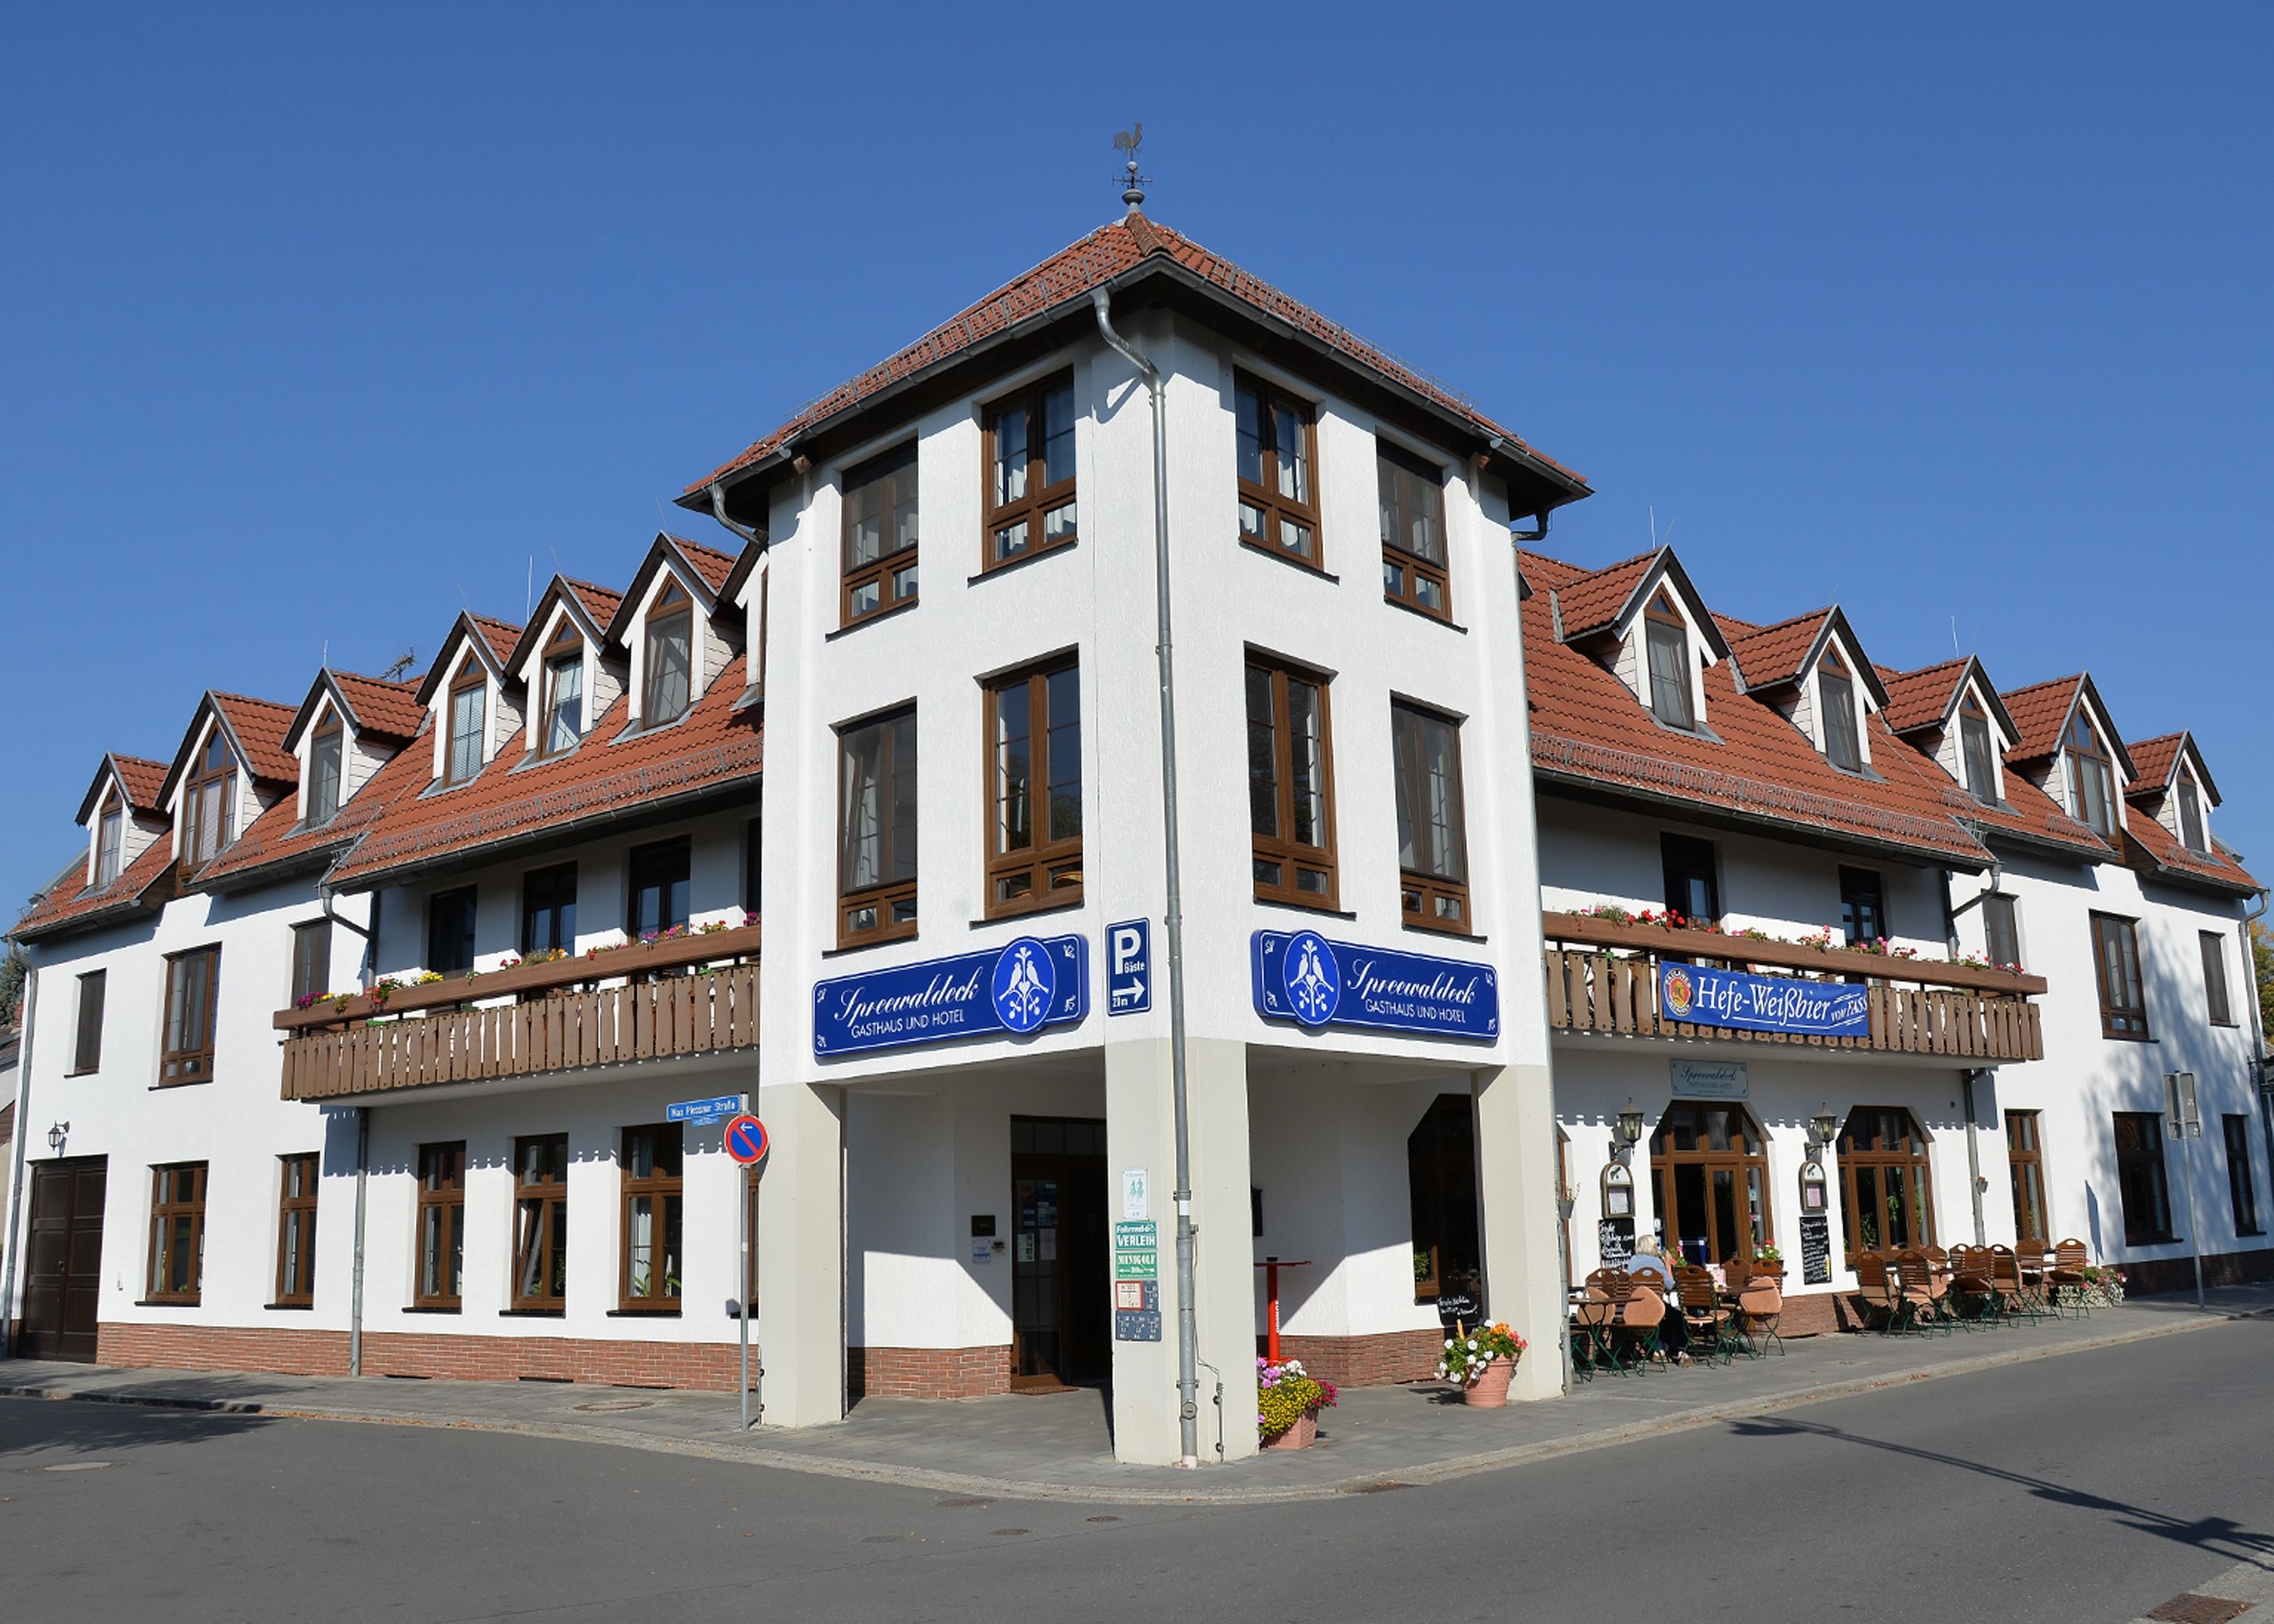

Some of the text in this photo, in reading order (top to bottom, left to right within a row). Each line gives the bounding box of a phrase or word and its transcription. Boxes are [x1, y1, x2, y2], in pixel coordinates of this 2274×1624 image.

[1114, 928, 1142, 975] P
[1124, 960, 1145, 974] Gäste
[1347, 959, 1479, 1004] Spreewaldeck
[834, 965, 984, 1028] Spreewaldeck
[1696, 977, 1831, 1025] Hefe-Weißbier
[1846, 995, 1867, 1016] FASS
[851, 1009, 964, 1038] GASTHAUS UND HOTEL
[1365, 999, 1466, 1023] GASTHAUS UND HOTEL
[715, 1100, 735, 1112] Straße
[1117, 1234, 1155, 1247] VERLEIH
